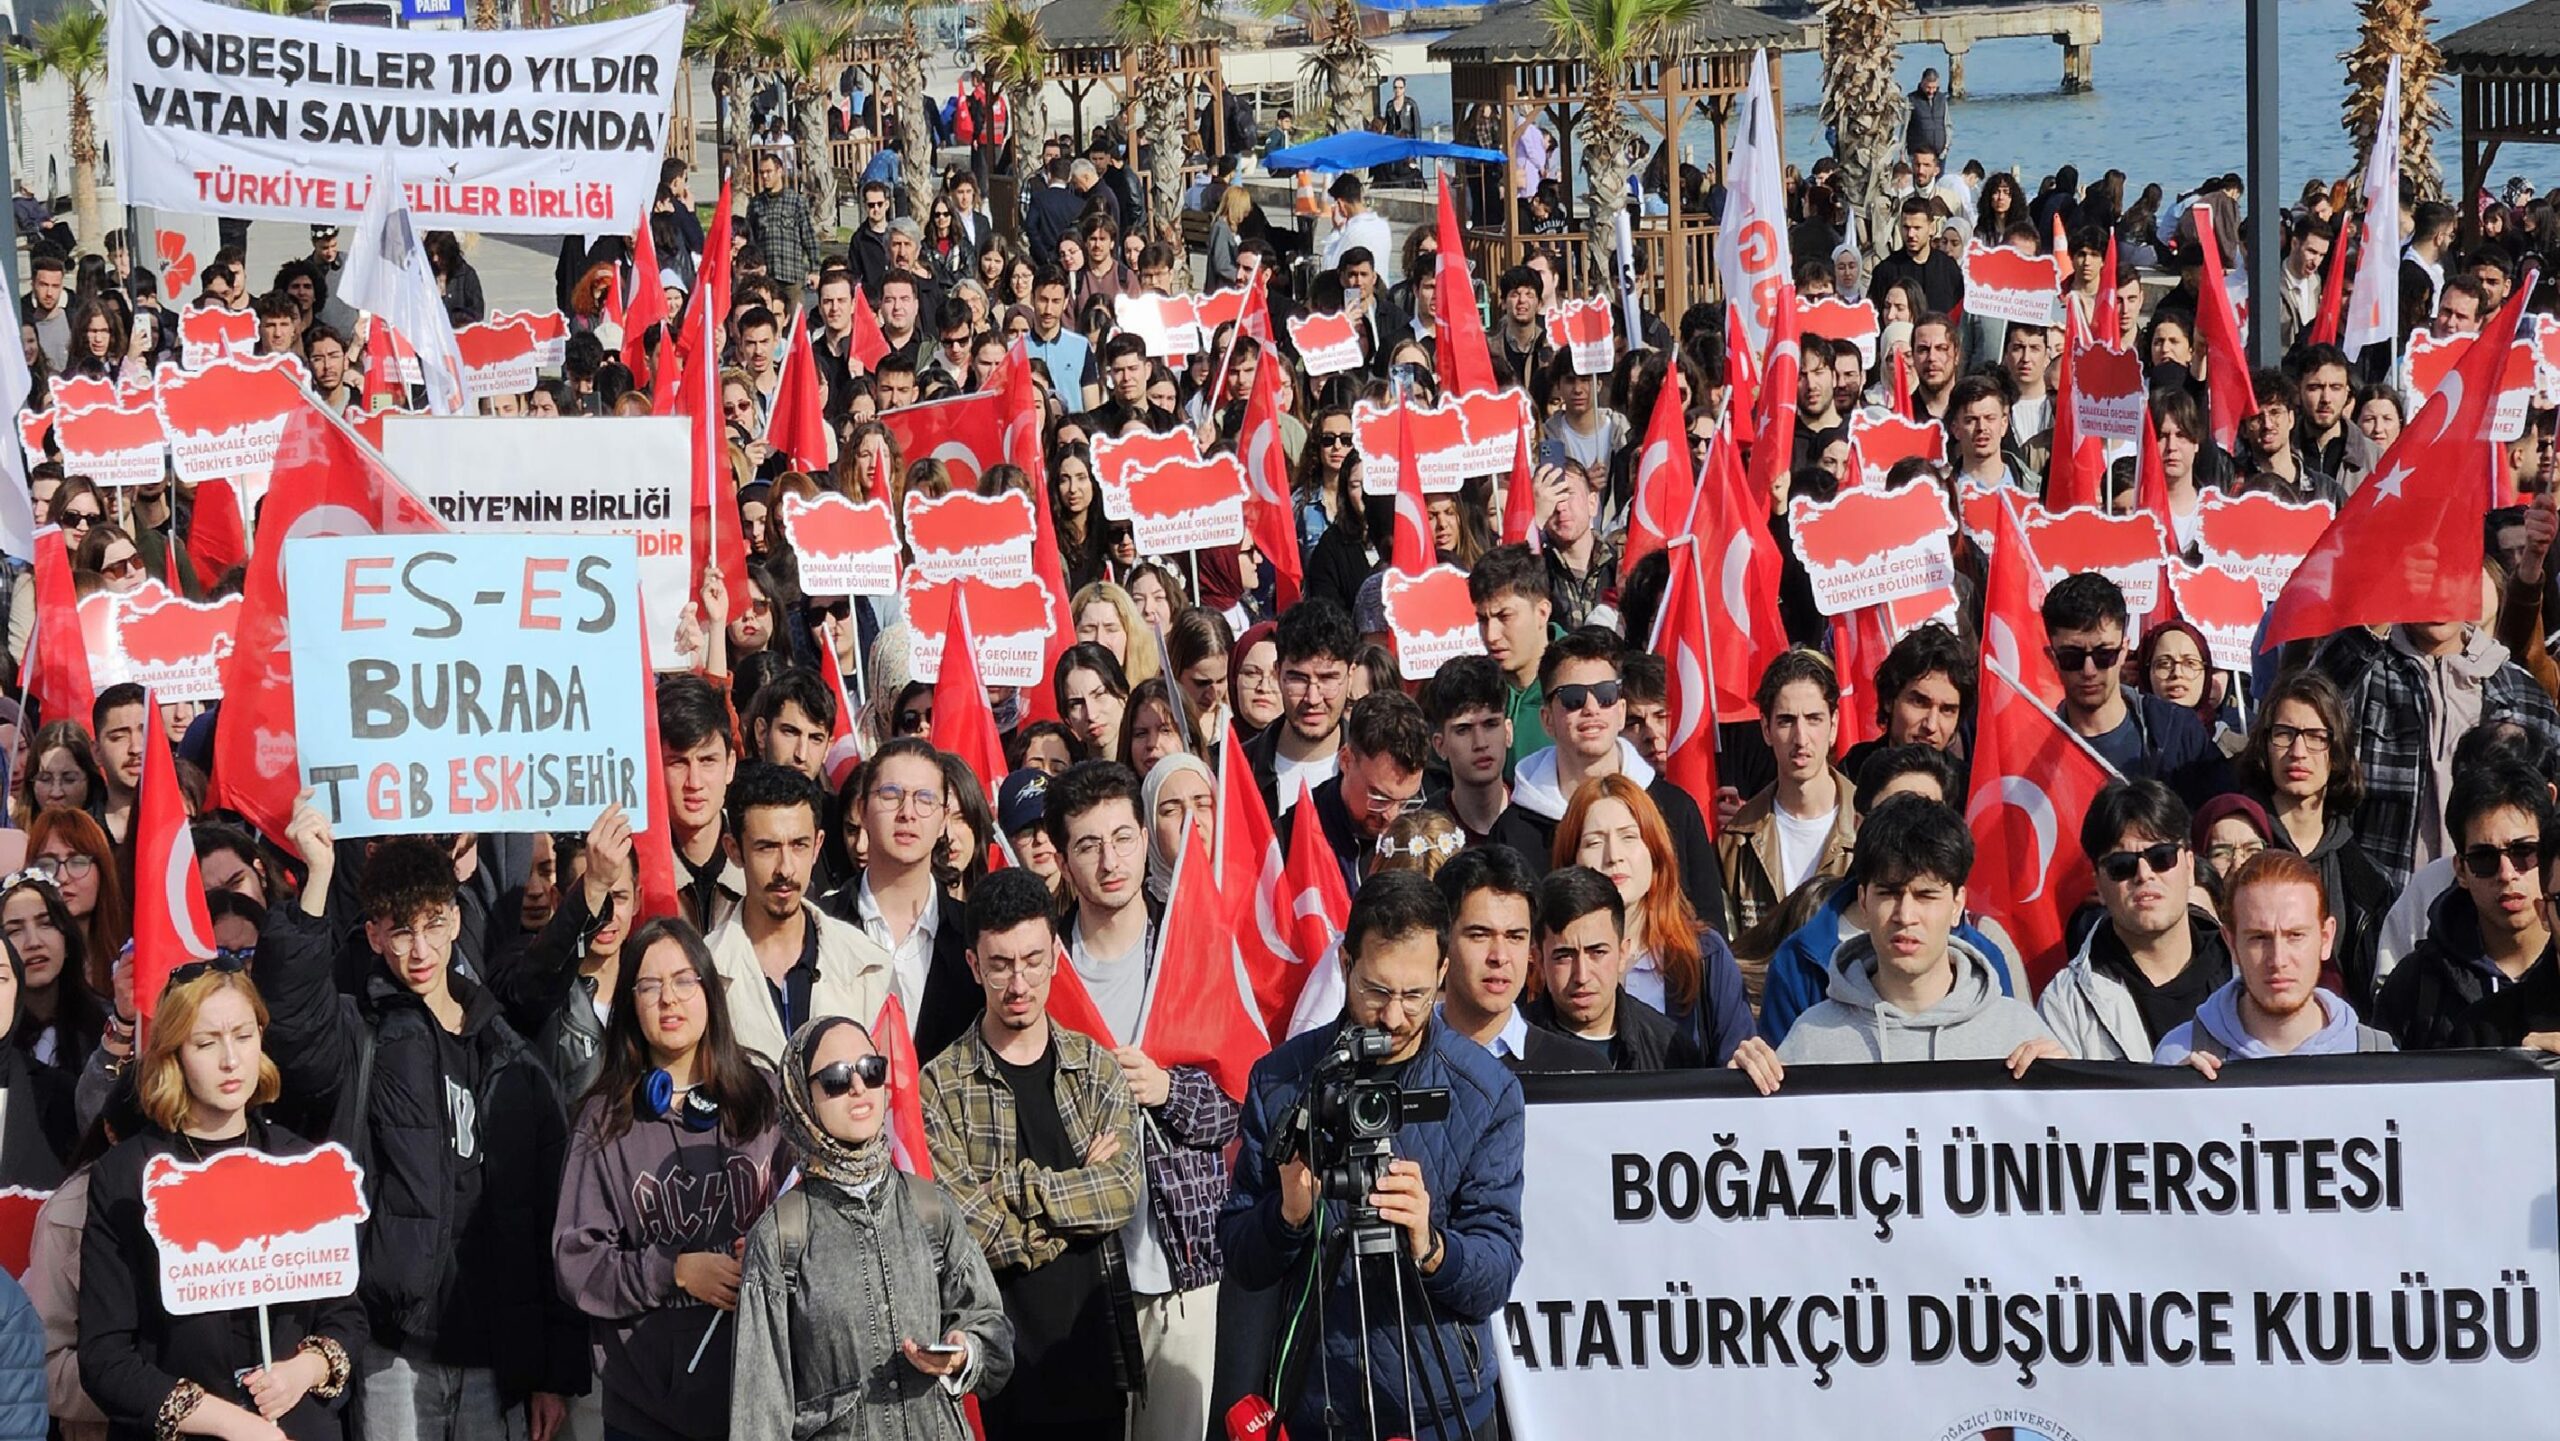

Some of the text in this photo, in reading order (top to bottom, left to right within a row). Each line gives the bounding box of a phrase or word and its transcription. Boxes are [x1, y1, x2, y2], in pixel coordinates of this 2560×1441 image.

[448, 54, 512, 94] 110
[525, 54, 659, 96] YILDIR
[133, 83, 288, 140] VATAN
[194, 165, 615, 220] TÜRKİYE LİELİLER BİRLİĞİ
[177, 438, 246, 458] ÇANAKKALE
[184, 455, 233, 473] TÜRKİYE
[1420, 461, 1460, 474] GEÇİLMEZ
[570, 487, 671, 522] BİRLİĞİ
[1138, 513, 1239, 538] ÇANAKKALE GEÇİLMEZ
[1143, 528, 1236, 550] TÜRKİYE BÖLÜNMEZ
[802, 560, 893, 575] ÇANAKKALE GEÇİLMEZ
[980, 554, 1027, 568] GEÇİLMEZ
[1816, 552, 1946, 590] ÇANAKKALE GEÇİLMEZ
[341, 551, 616, 639] ES-ES
[808, 574, 890, 588] TÜRKİYE BÖLÜNMEZ
[1825, 568, 1945, 606] TÜRKİYE BÖLÜNMEZ
[985, 646, 1038, 662] GEÇİLMEZ
[1403, 639, 1464, 658] ÇANAKKALE
[348, 659, 591, 740] BURADA
[448, 747, 638, 817] ESKİŞEHİR
[1611, 1118, 2403, 1242] BOĞAZİÇİ ÜNİVERSİTESİ
[168, 1246, 351, 1284] ÇANAKKALE GEÇİLMEZ
[176, 1271, 343, 1303] TÜRKİYE BÖLÜNMEZ
[1503, 1269, 2541, 1389] ATATÜRKÇÜ DÜŞÜNCE KULÜBÜ
